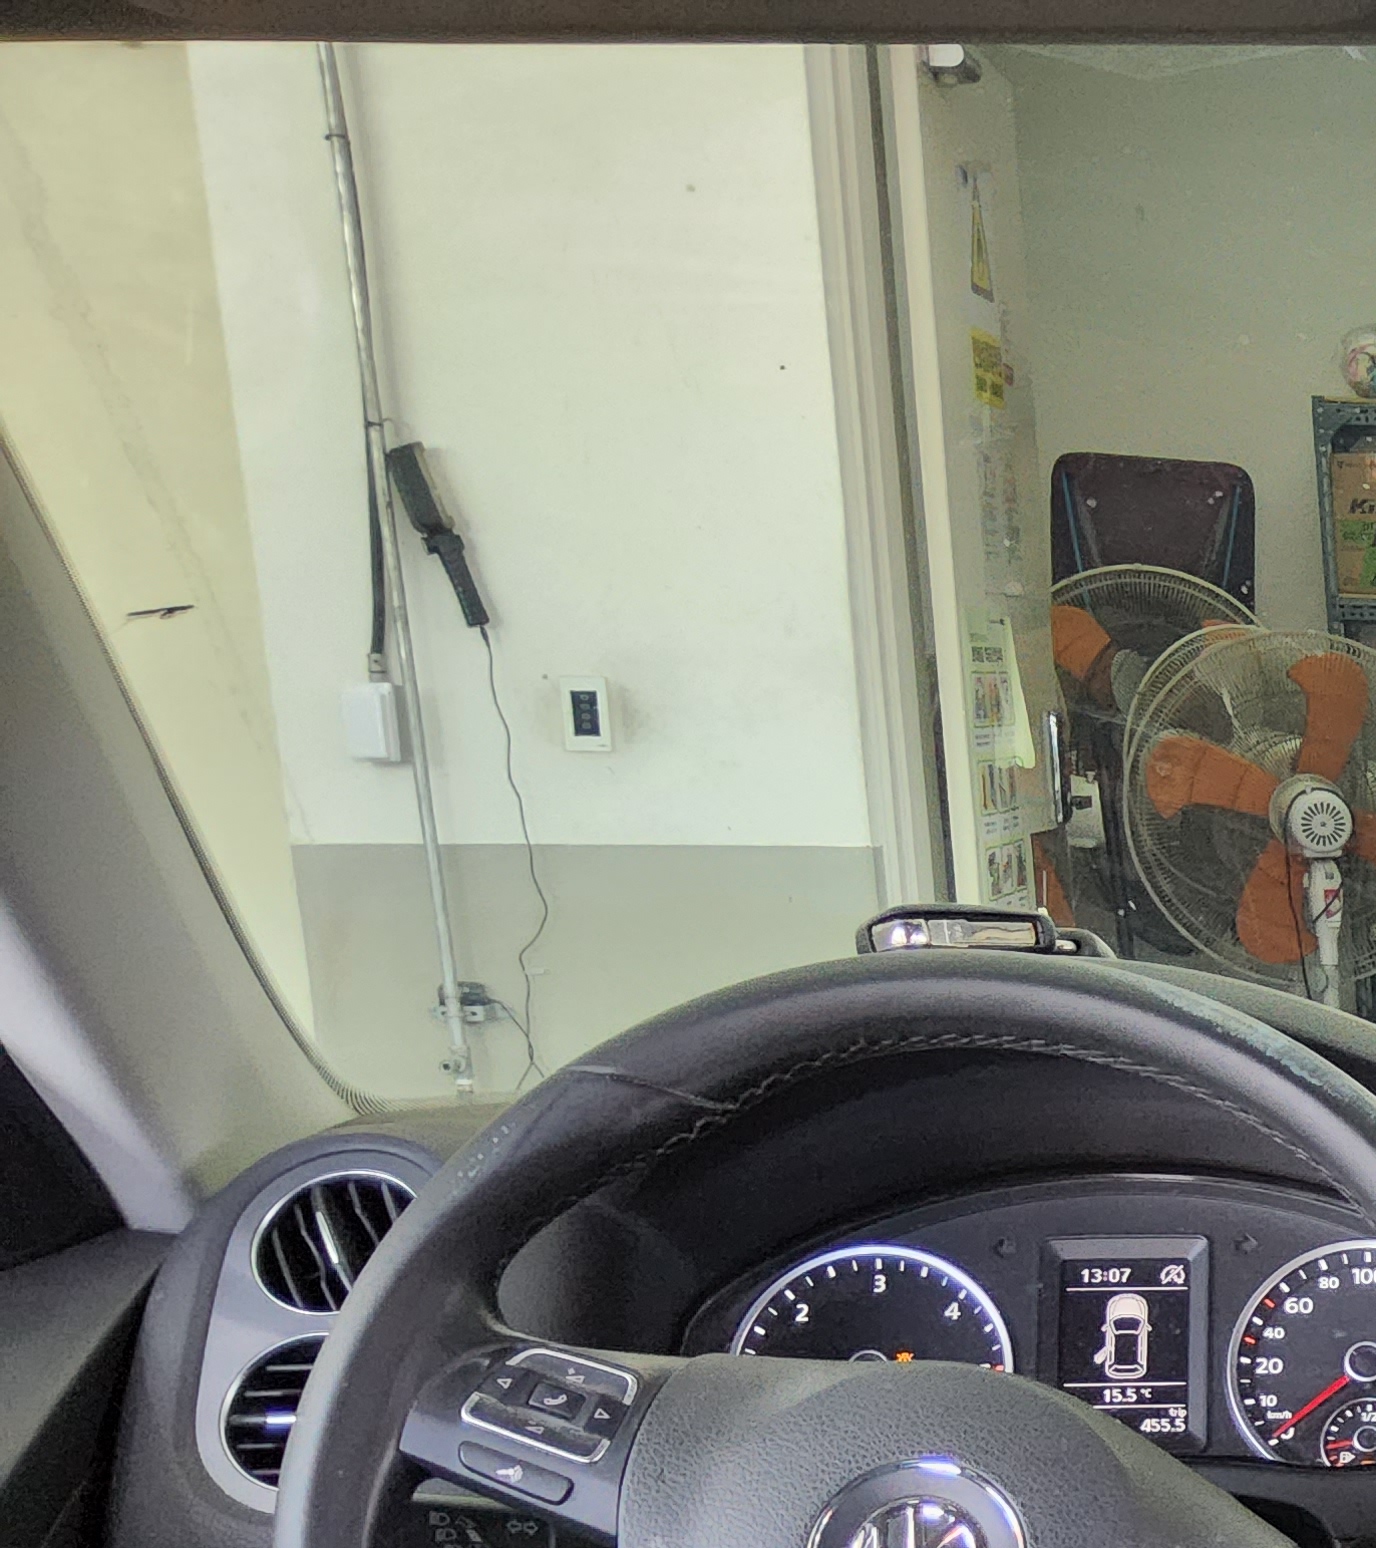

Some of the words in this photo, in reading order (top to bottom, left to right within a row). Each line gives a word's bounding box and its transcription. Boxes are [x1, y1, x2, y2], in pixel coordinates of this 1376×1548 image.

[1080, 1267, 1132, 1284] 13:07
[1317, 1276, 1340, 1290] 80
[872, 1275, 887, 1293] 3
[795, 1303, 810, 1323] 2
[943, 1301, 962, 1321] 4
[1283, 1297, 1314, 1315] 60
[1262, 1327, 1286, 1340] 40
[1254, 1357, 1284, 1375] 20
[1102, 1387, 1138, 1403] 15.5
[1259, 1395, 1278, 1407] 10
[1168, 1408, 1188, 1418] trip
[1139, 1418, 1186, 1433] 455.5
